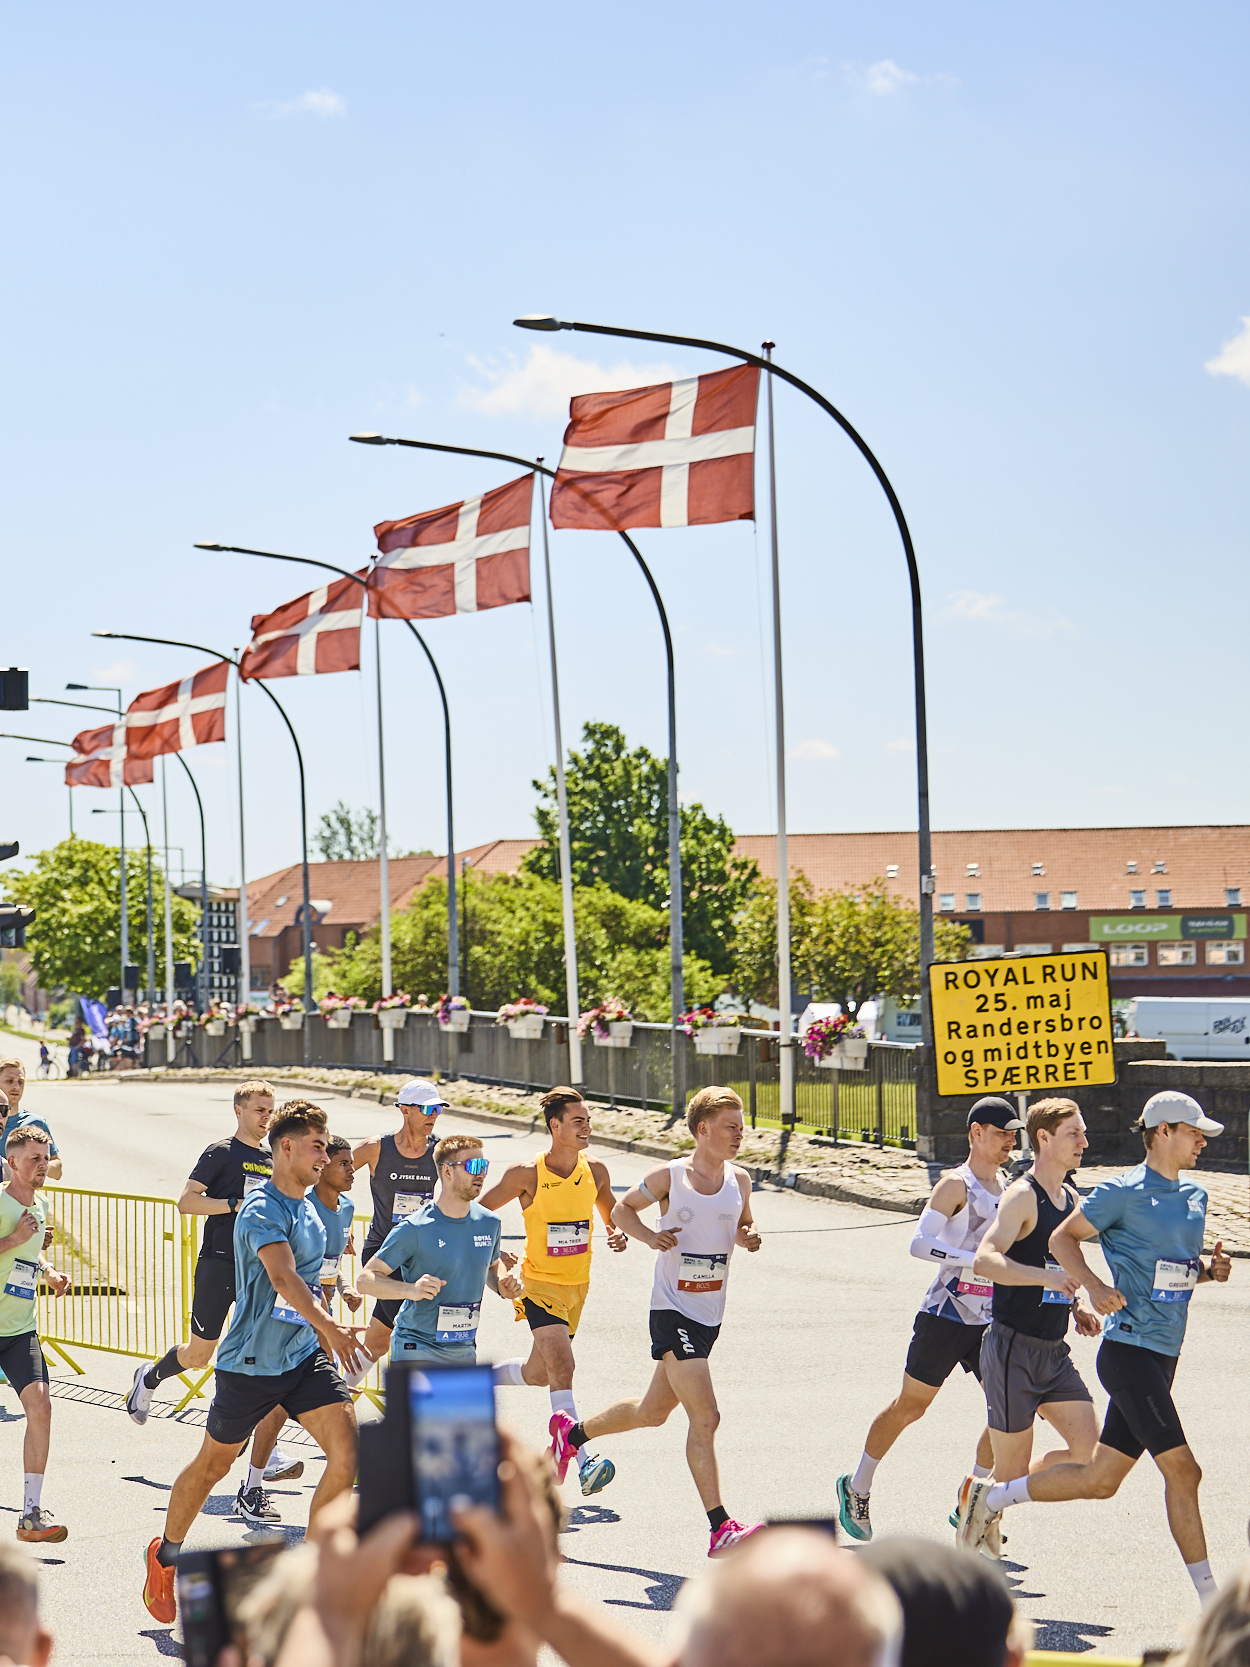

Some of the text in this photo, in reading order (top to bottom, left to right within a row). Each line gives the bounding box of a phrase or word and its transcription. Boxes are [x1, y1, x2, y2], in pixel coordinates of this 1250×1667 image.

[944, 962, 1098, 990] ROYAL RUN
[976, 988, 1071, 1012] 25. maj
[947, 1014, 1102, 1040] Randersbro
[944, 1040, 1109, 1067] og midtbyen
[964, 1061, 1093, 1088] SPÆRRET
